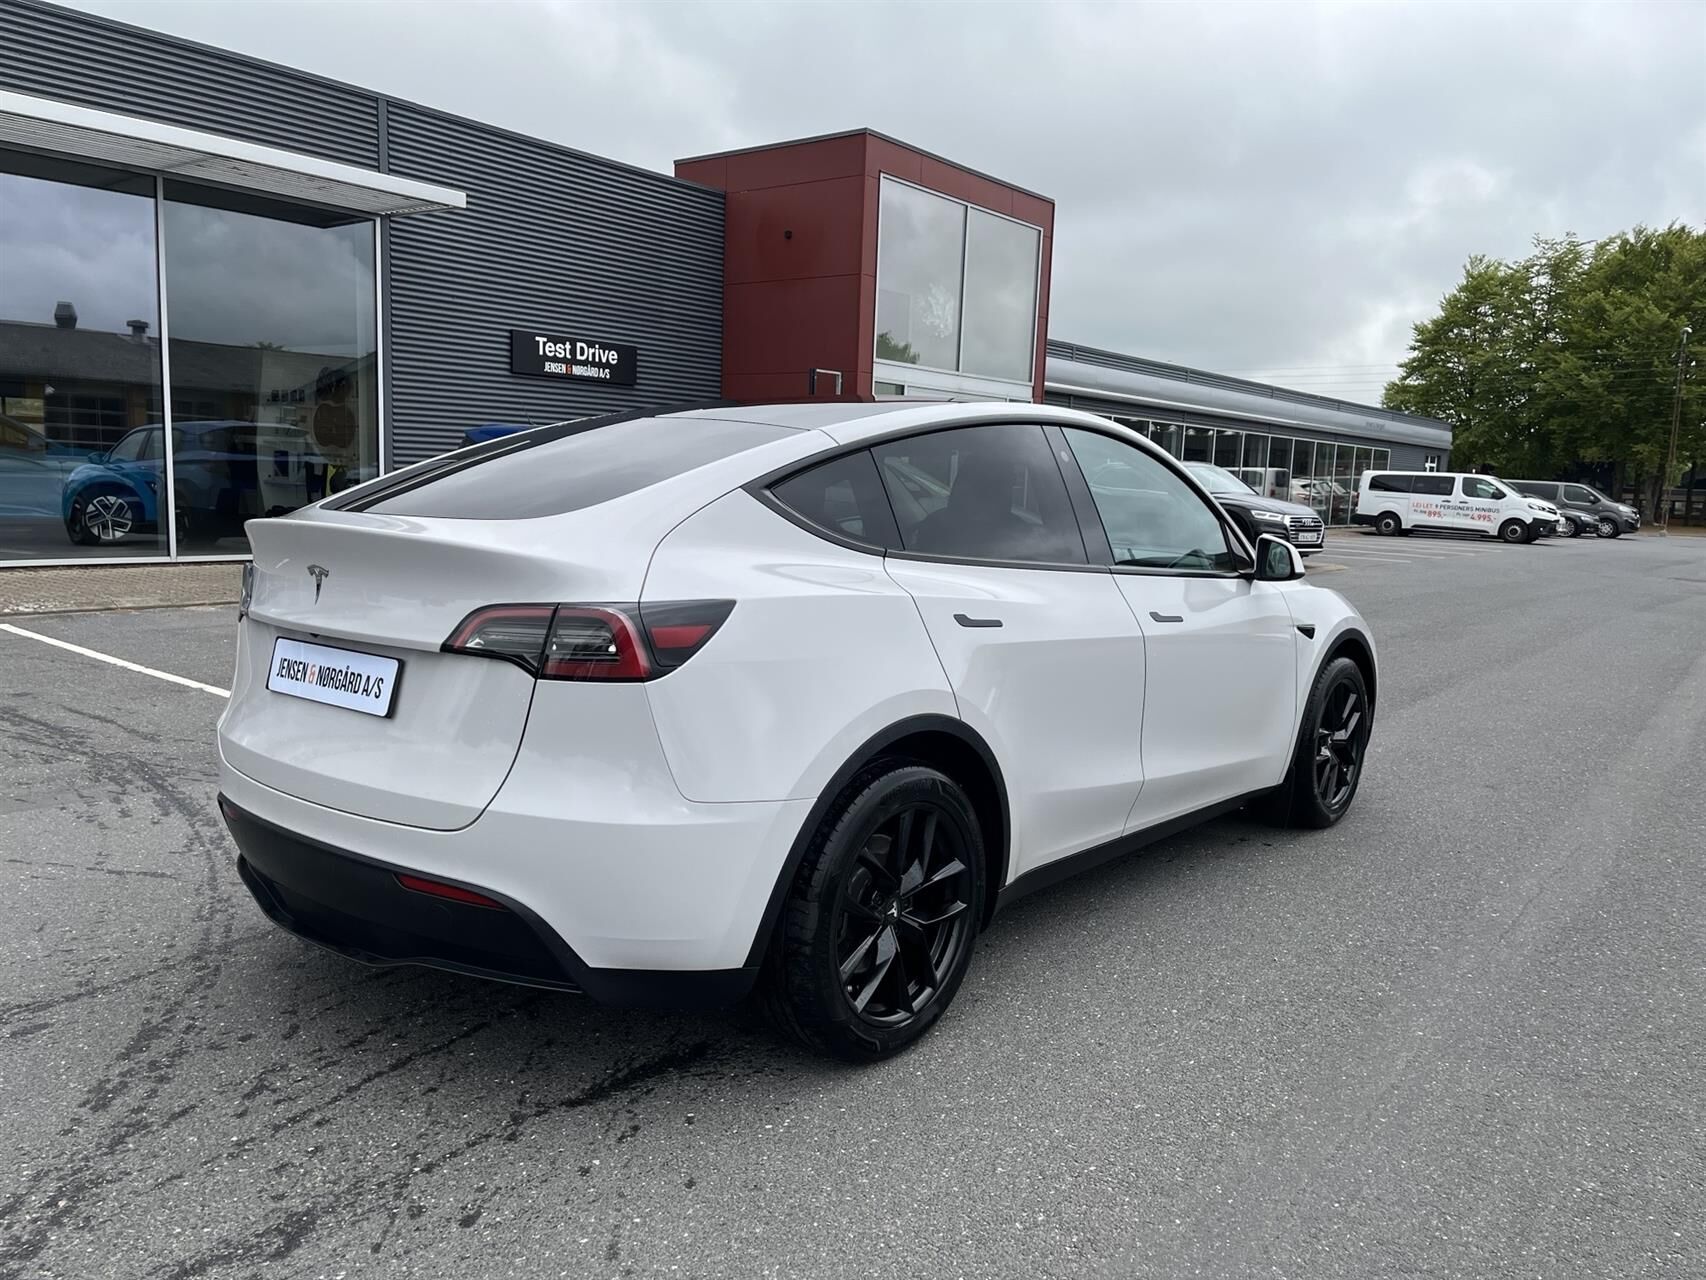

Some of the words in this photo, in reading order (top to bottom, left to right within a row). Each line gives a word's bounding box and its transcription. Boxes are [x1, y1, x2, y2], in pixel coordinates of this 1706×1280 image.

[535, 336, 571, 359] Test
[576, 341, 618, 365] Drive
[544, 361, 566, 374] JENSEN
[566, 363, 572, 375] &
[599, 368, 610, 379] A/S
[1440, 503, 1474, 512] PERSONERS
[1475, 506, 1500, 514] MINIBUS
[277, 657, 309, 684] JENSEN
[308, 664, 316, 684] &
[315, 665, 363, 694] NØRGÅRD
[361, 675, 384, 699] A/S
